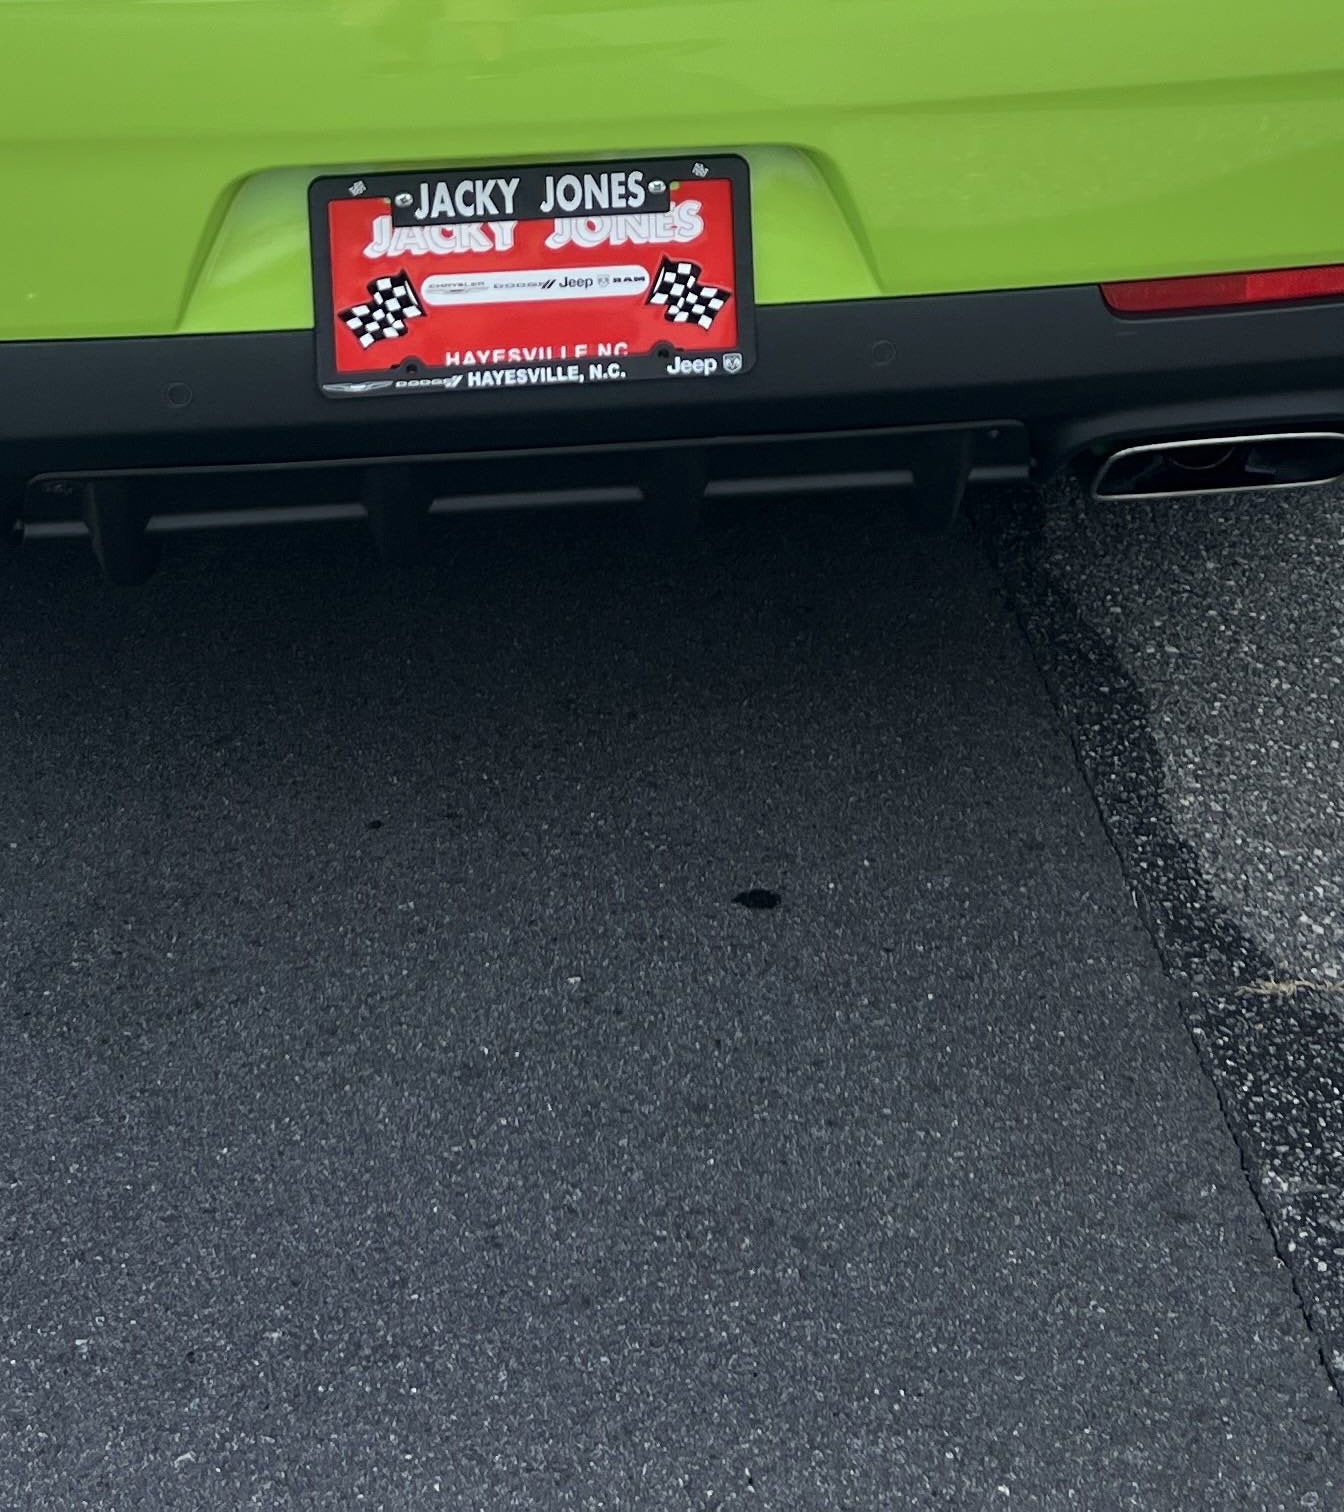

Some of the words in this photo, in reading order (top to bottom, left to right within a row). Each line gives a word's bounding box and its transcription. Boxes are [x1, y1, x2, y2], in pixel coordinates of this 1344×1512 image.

[414, 178, 520, 219] JACKY
[540, 171, 646, 213] JONES
[559, 276, 593, 288] Jeep
[467, 365, 585, 387] HAYESVILLE,
[589, 362, 626, 380] N.C.
[666, 356, 718, 376] Jeep
